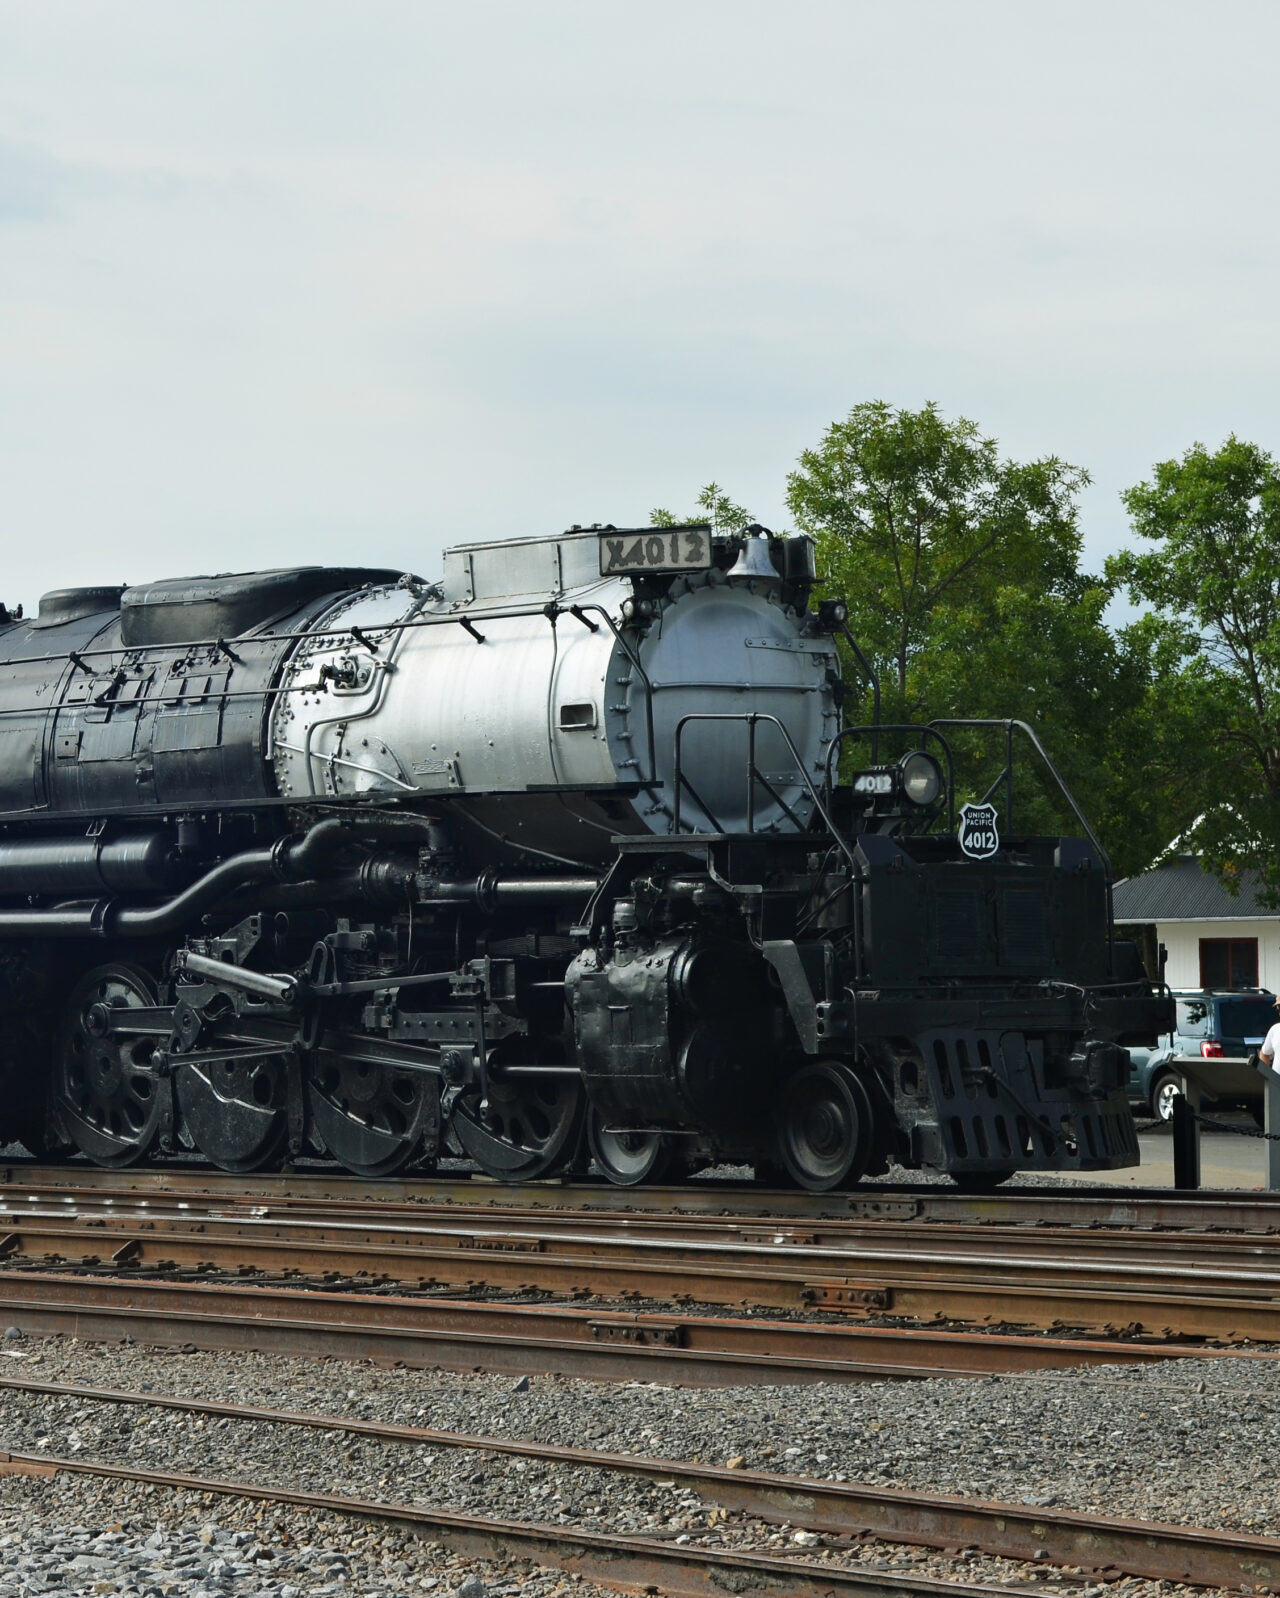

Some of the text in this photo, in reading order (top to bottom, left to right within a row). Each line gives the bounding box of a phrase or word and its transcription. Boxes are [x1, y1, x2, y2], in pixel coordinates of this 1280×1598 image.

[606, 531, 704, 568] X4012
[854, 774, 892, 793] 4012
[964, 831, 995, 849] 4012
